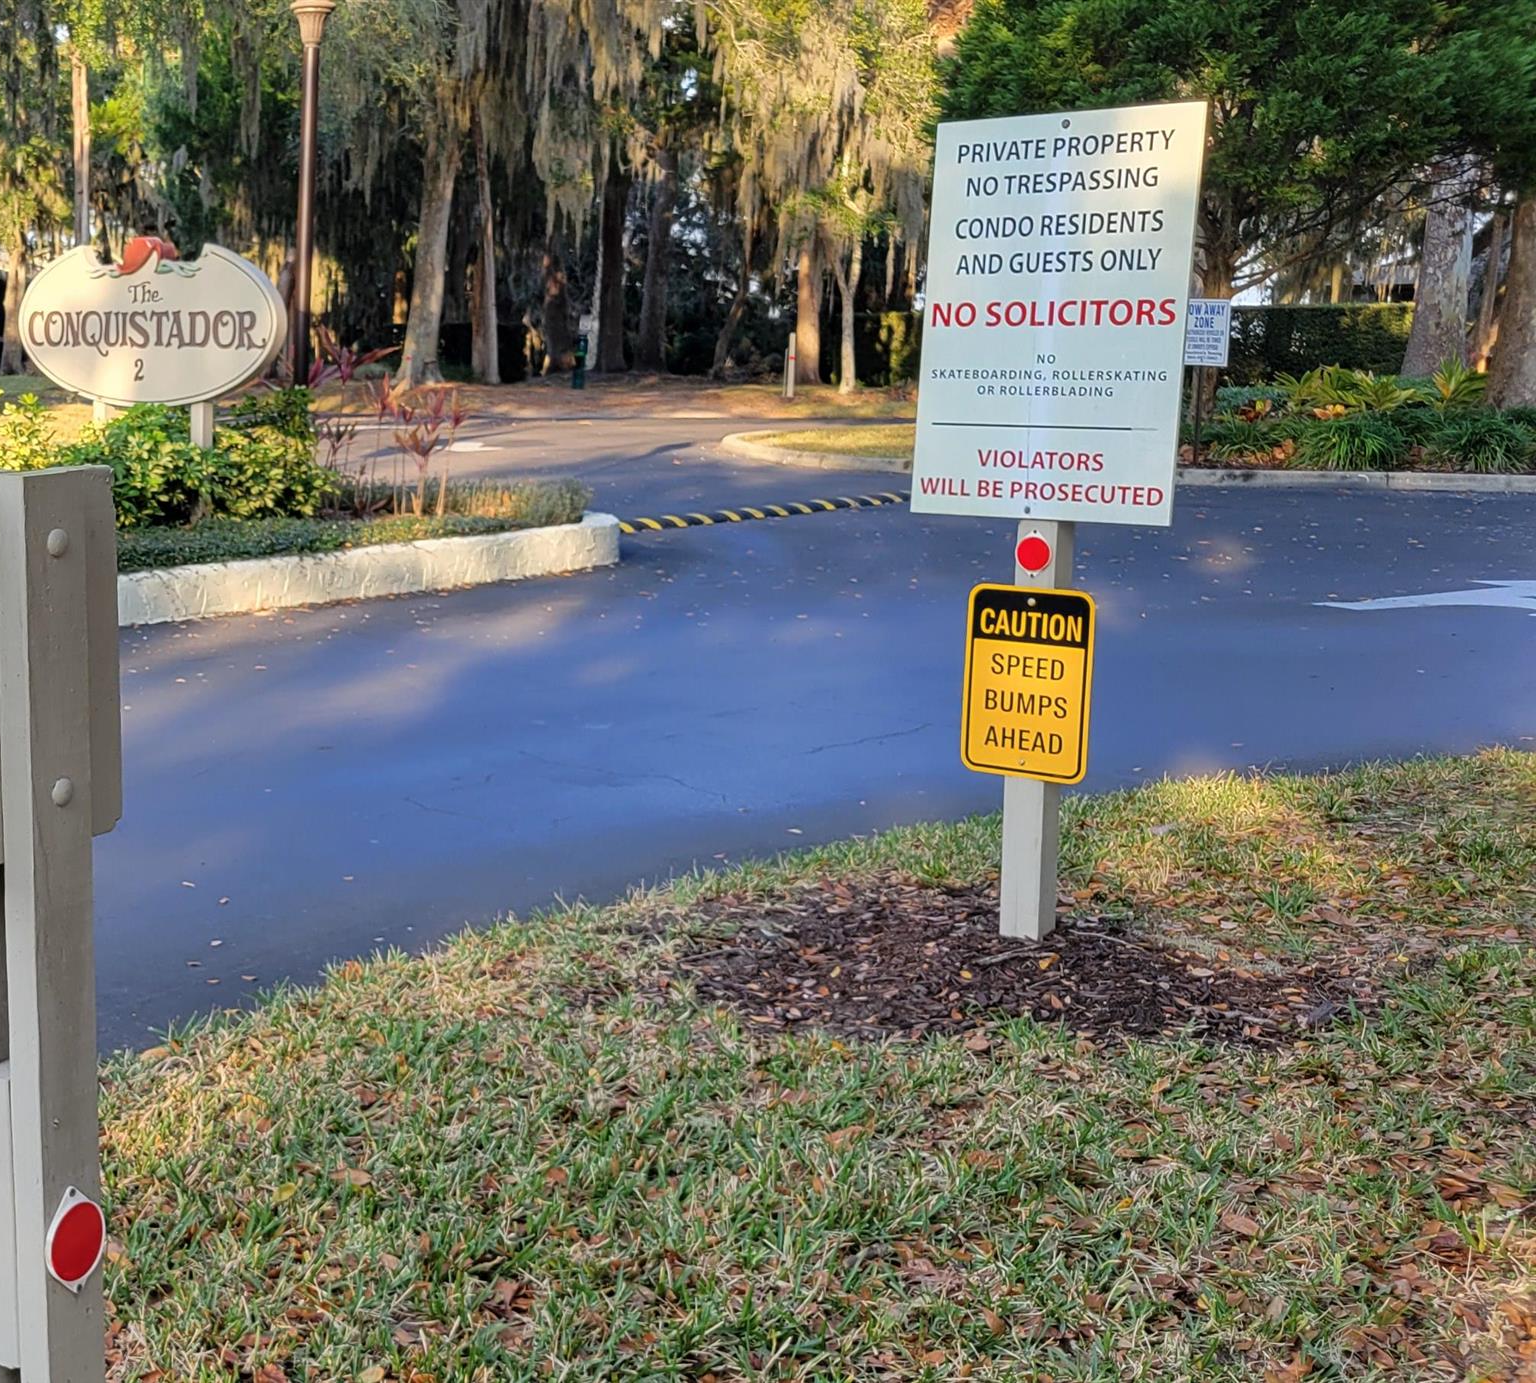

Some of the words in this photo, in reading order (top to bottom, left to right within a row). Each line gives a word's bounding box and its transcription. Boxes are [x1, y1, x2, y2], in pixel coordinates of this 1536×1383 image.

[957, 139, 1046, 163] PRIVATE
[1053, 129, 1175, 159] PROPERTY
[966, 176, 997, 197] NO
[1004, 166, 1159, 195] TRESPASSING
[955, 215, 1034, 240] CONDO
[1040, 210, 1164, 236] RESIDENTS
[956, 253, 1003, 275] AND
[1009, 250, 1093, 273] GUESTS
[1100, 248, 1162, 271] ONLY
[128, 281, 164, 304] The
[931, 302, 976, 328] NO
[985, 298, 1176, 328] SOLICITORS
[1189, 303, 1202, 316] OW
[1204, 303, 1226, 316] AWAY
[1194, 316, 1215, 328] ZONE
[28, 310, 266, 357] CONQUISTADOR
[133, 358, 145, 382] 2
[1036, 353, 1057, 365] NO
[931, 369, 1047, 382] SKATEBOARDING,
[1052, 369, 1168, 382] ROLLERSKATING
[976, 385, 996, 396] OR
[999, 385, 1114, 397] ROLLERBLADING
[977, 448, 1104, 472] VIOLATORS
[920, 477, 971, 498] WILL
[977, 480, 1003, 499] BE
[1009, 482, 1164, 507] PROSECUTED
[980, 607, 1083, 643] CAUTION
[991, 653, 1064, 681] SPEED
[984, 688, 1068, 719] BUMPS
[984, 725, 1063, 755] AHEAD
